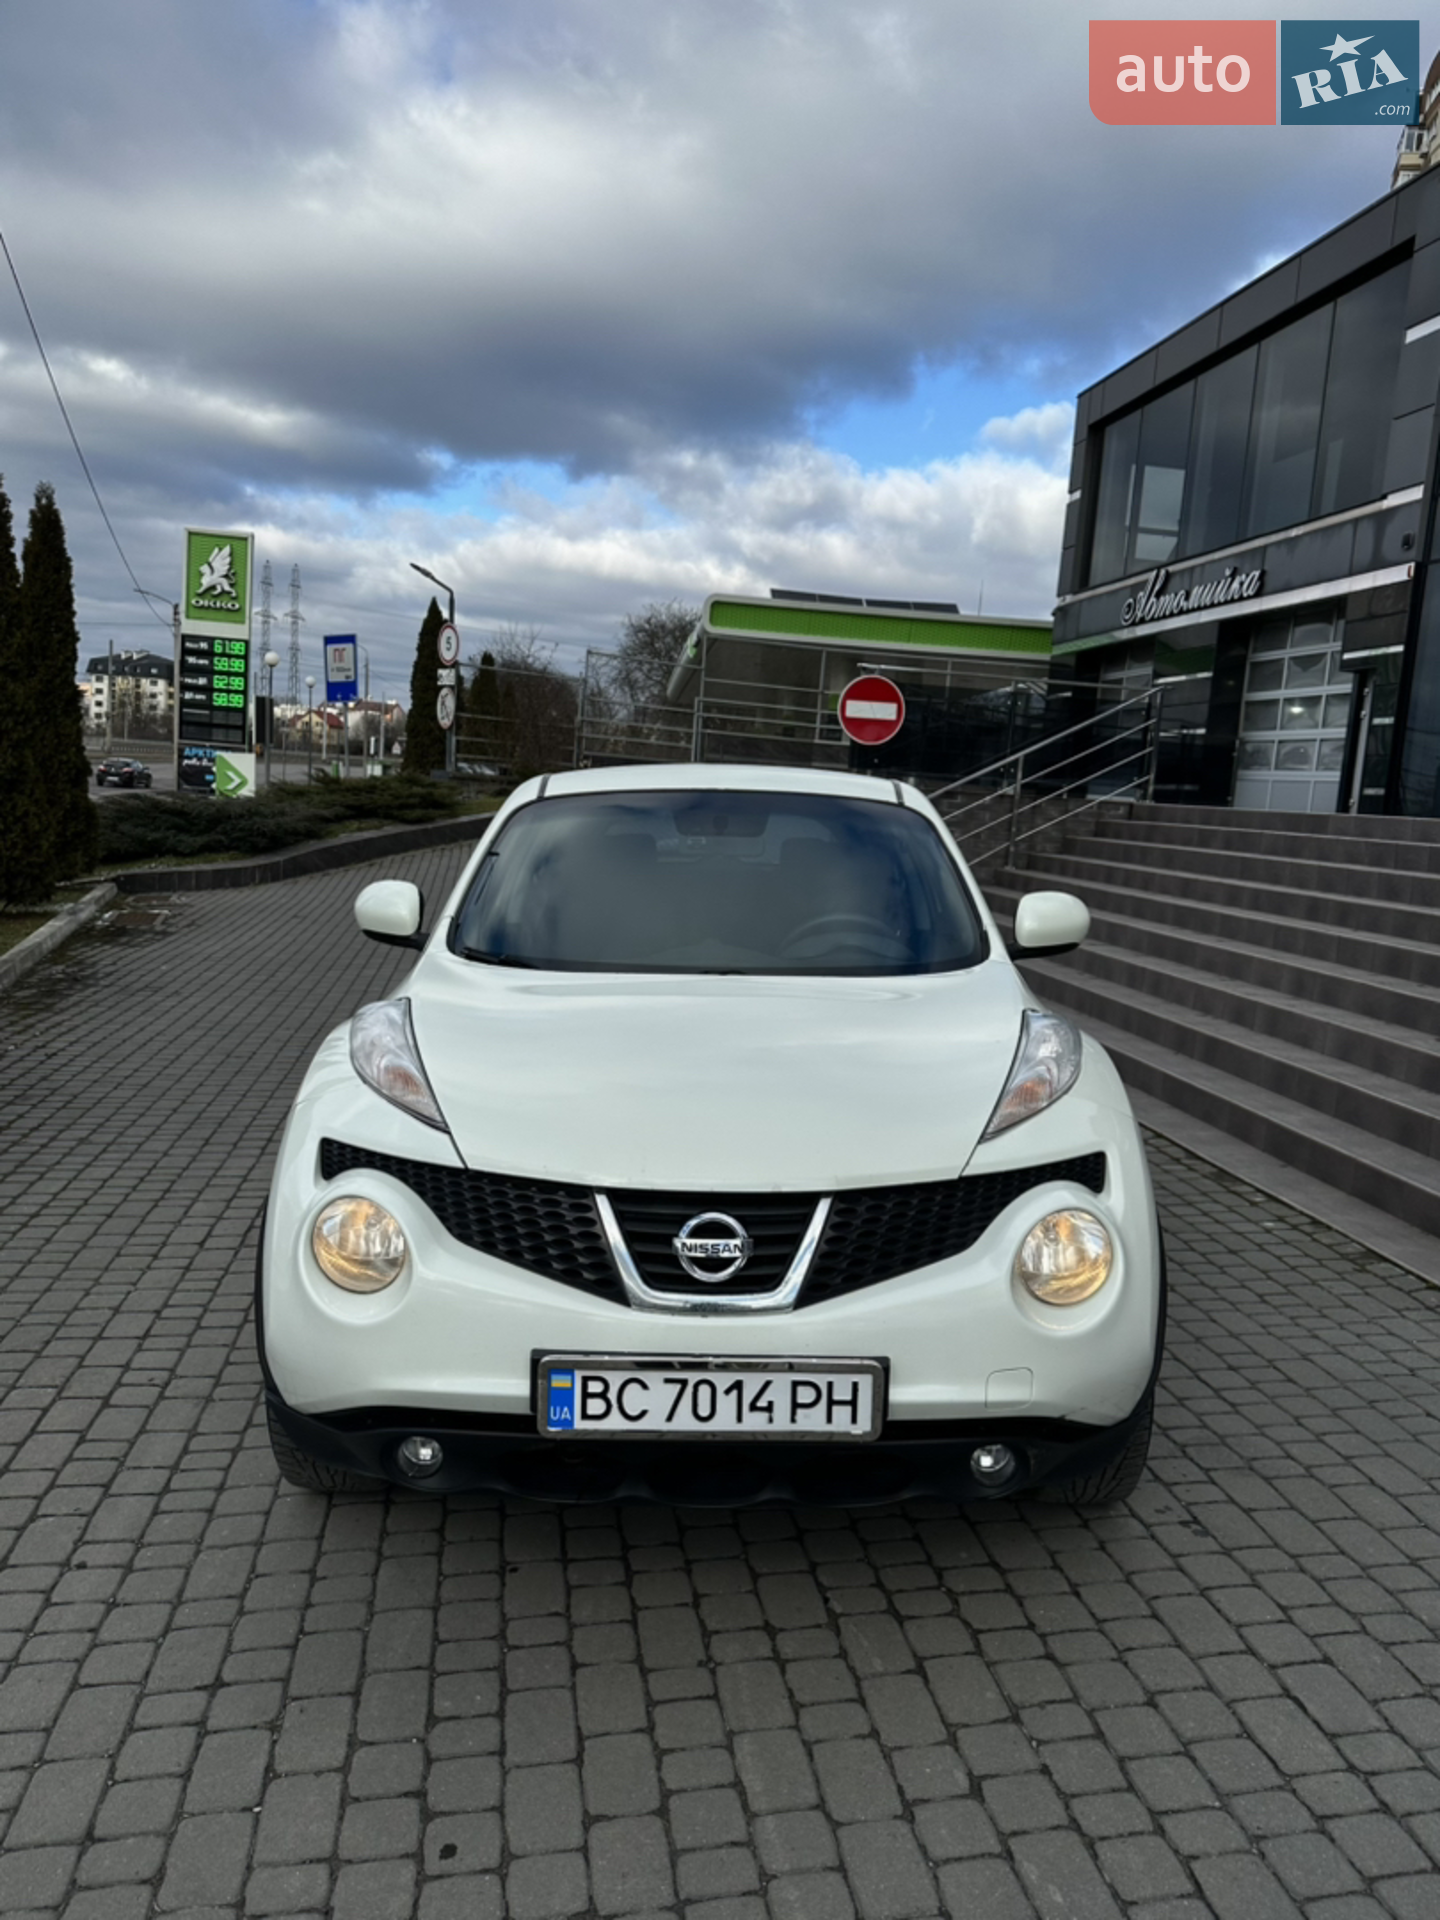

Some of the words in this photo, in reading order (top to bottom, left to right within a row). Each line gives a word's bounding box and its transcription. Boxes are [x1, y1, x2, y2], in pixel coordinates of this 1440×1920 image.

[1120, 567, 1262, 626] Автомийка
[445, 636, 452, 651] 5
[680, 1241, 744, 1255] NISSAN
[580, 1375, 650, 1422] BC
[662, 1377, 774, 1424] 7014
[790, 1379, 859, 1425] PH
[550, 1406, 571, 1421] UA
